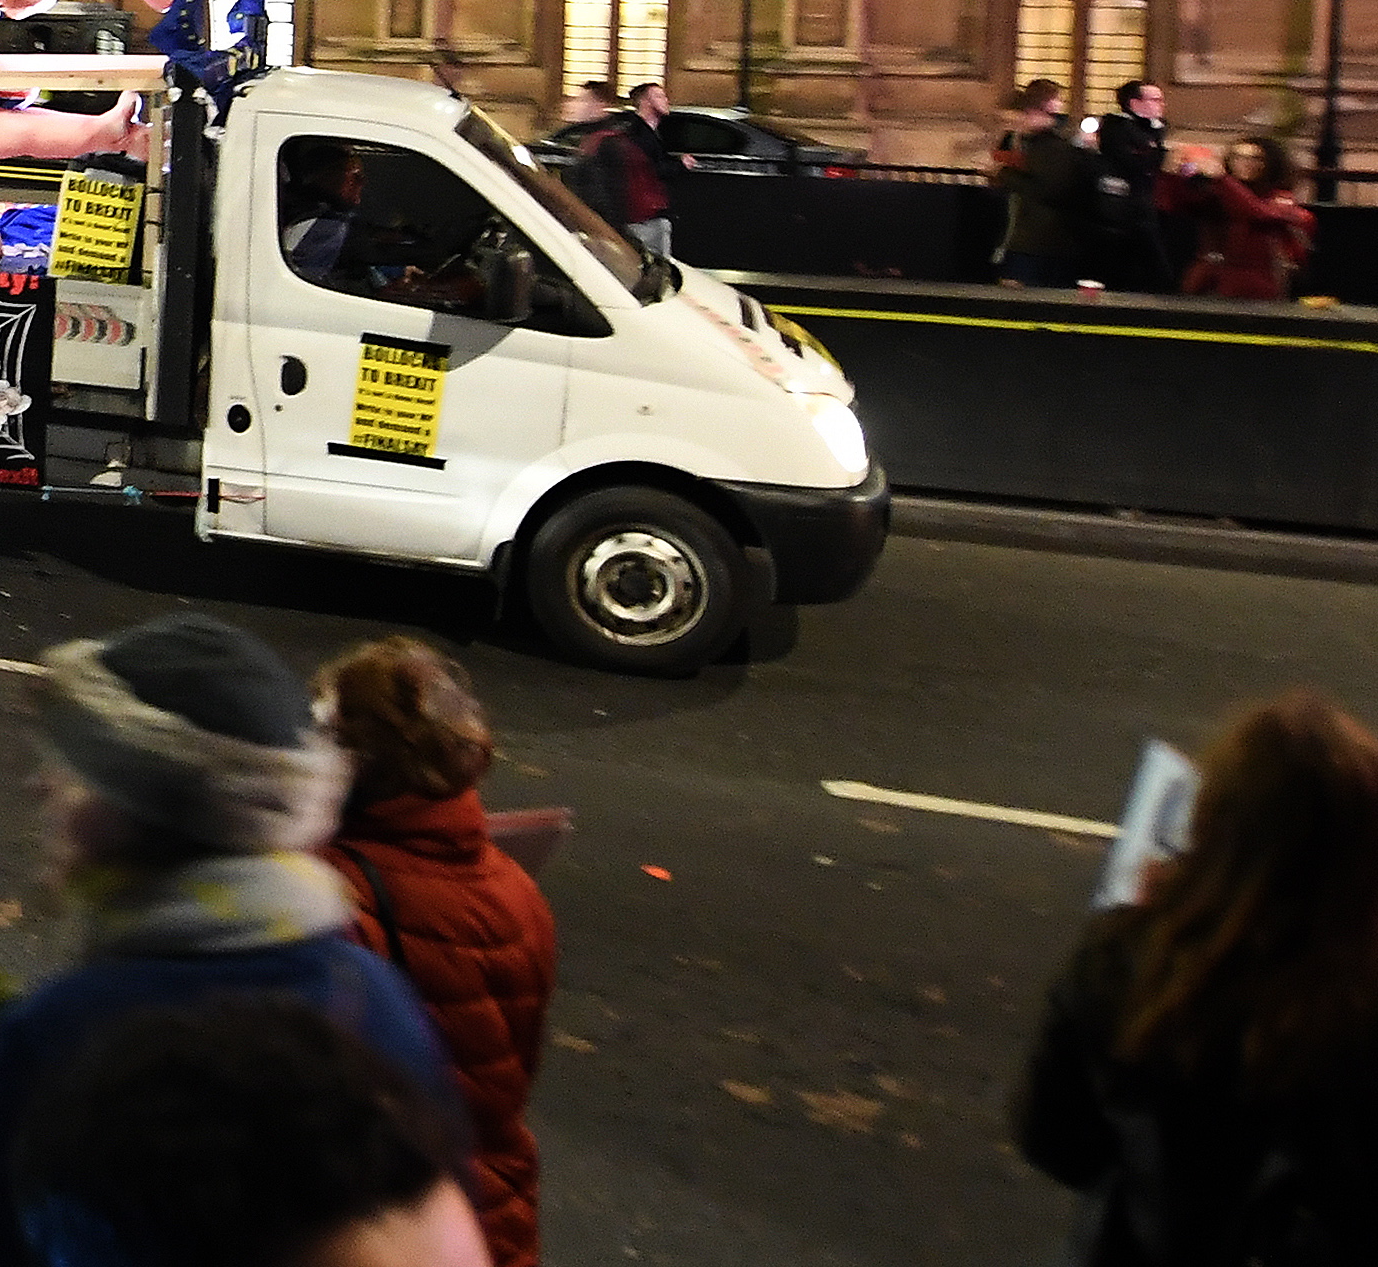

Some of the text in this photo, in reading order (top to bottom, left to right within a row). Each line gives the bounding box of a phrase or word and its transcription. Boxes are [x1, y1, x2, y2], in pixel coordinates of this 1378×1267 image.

[65, 198, 133, 221] TO BREXIT
[361, 367, 437, 392] TO BREXIT
